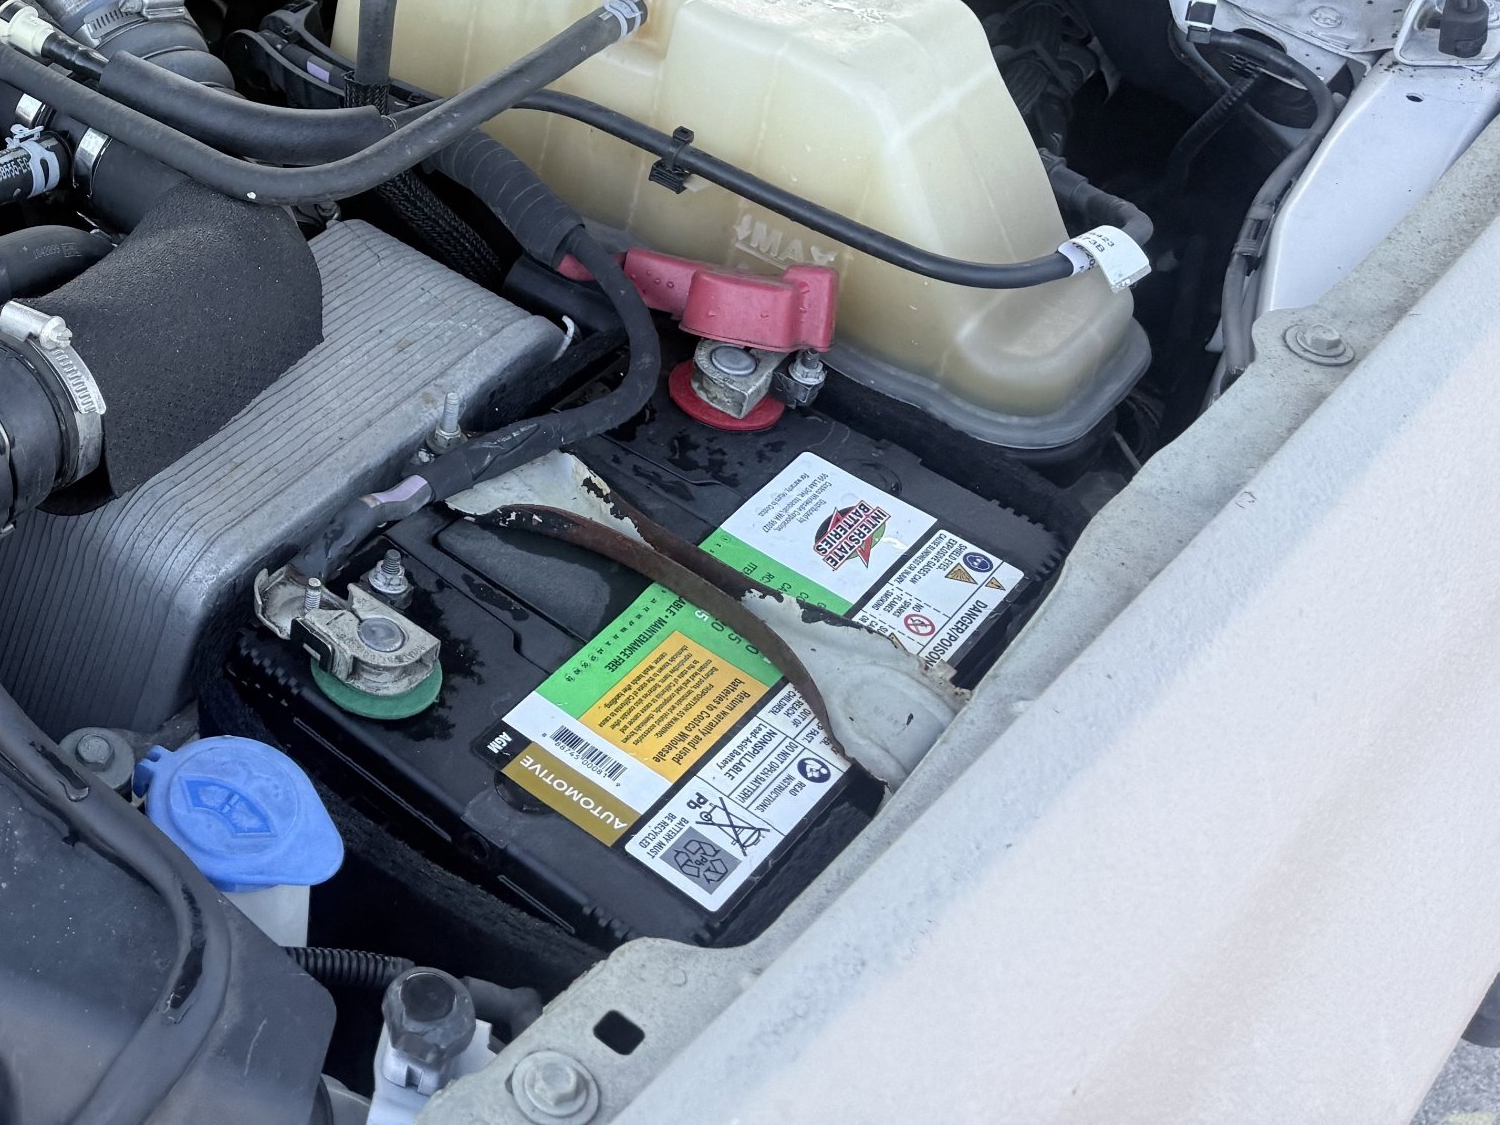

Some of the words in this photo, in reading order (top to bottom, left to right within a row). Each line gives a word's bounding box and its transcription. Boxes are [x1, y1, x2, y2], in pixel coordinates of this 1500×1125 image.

[813, 502, 872, 555] BATTERIES
[824, 507, 889, 567] INTERSTATE
[930, 532, 947, 547] CAUSE
[929, 537, 957, 563] EXPLOSIVE
[947, 543, 967, 561] SHIELD
[906, 563, 917, 571] OR
[916, 559, 935, 576] GASES
[935, 557, 953, 572] EYES.
[908, 573, 922, 584] CAN
[870, 589, 894, 610] SMOKING
[882, 594, 903, 613] FLAMES
[891, 599, 912, 618] SPARKS
[911, 602, 924, 613] NO
[619, 616, 667, 658] MAINTENANCE
[920, 598, 988, 667] DANGER/POISON
[603, 655, 625, 672] FREE
[682, 683, 714, 712] PROPOSITION
[711, 677, 744, 706] batteries
[724, 689, 750, 712] Return
[704, 703, 717, 712] to
[767, 689, 796, 717] CHILDREN.
[783, 699, 803, 717] REACH
[683, 709, 711, 733] Costco
[696, 707, 729, 737] warranty
[789, 717, 801, 727] OF
[796, 707, 811, 721] OUT
[653, 715, 679, 739] WARNING:
[736, 722, 767, 752] Lead-Acid
[801, 727, 819, 744] FAST.
[486, 731, 513, 753] AGM
[651, 730, 689, 764] Wholesale
[686, 734, 704, 749] and
[784, 741, 798, 753] DO
[670, 745, 693, 765] used
[714, 747, 741, 771] Battery
[723, 728, 777, 781] NONSPILLABLE
[773, 749, 790, 764] NOT
[759, 761, 779, 778] OPEN
[517, 753, 627, 833] AUTOMOTIVE
[734, 774, 766, 803] BATTERY!
[753, 773, 795, 814] INSTRUCTIONS.
[787, 780, 806, 797] READ
[684, 791, 709, 812] Pb
[663, 812, 676, 822] BE
[637, 819, 668, 849] RECYCLED
[661, 816, 689, 842] BATTERY
[645, 839, 666, 859] MUST
[693, 854, 708, 867] Pb
